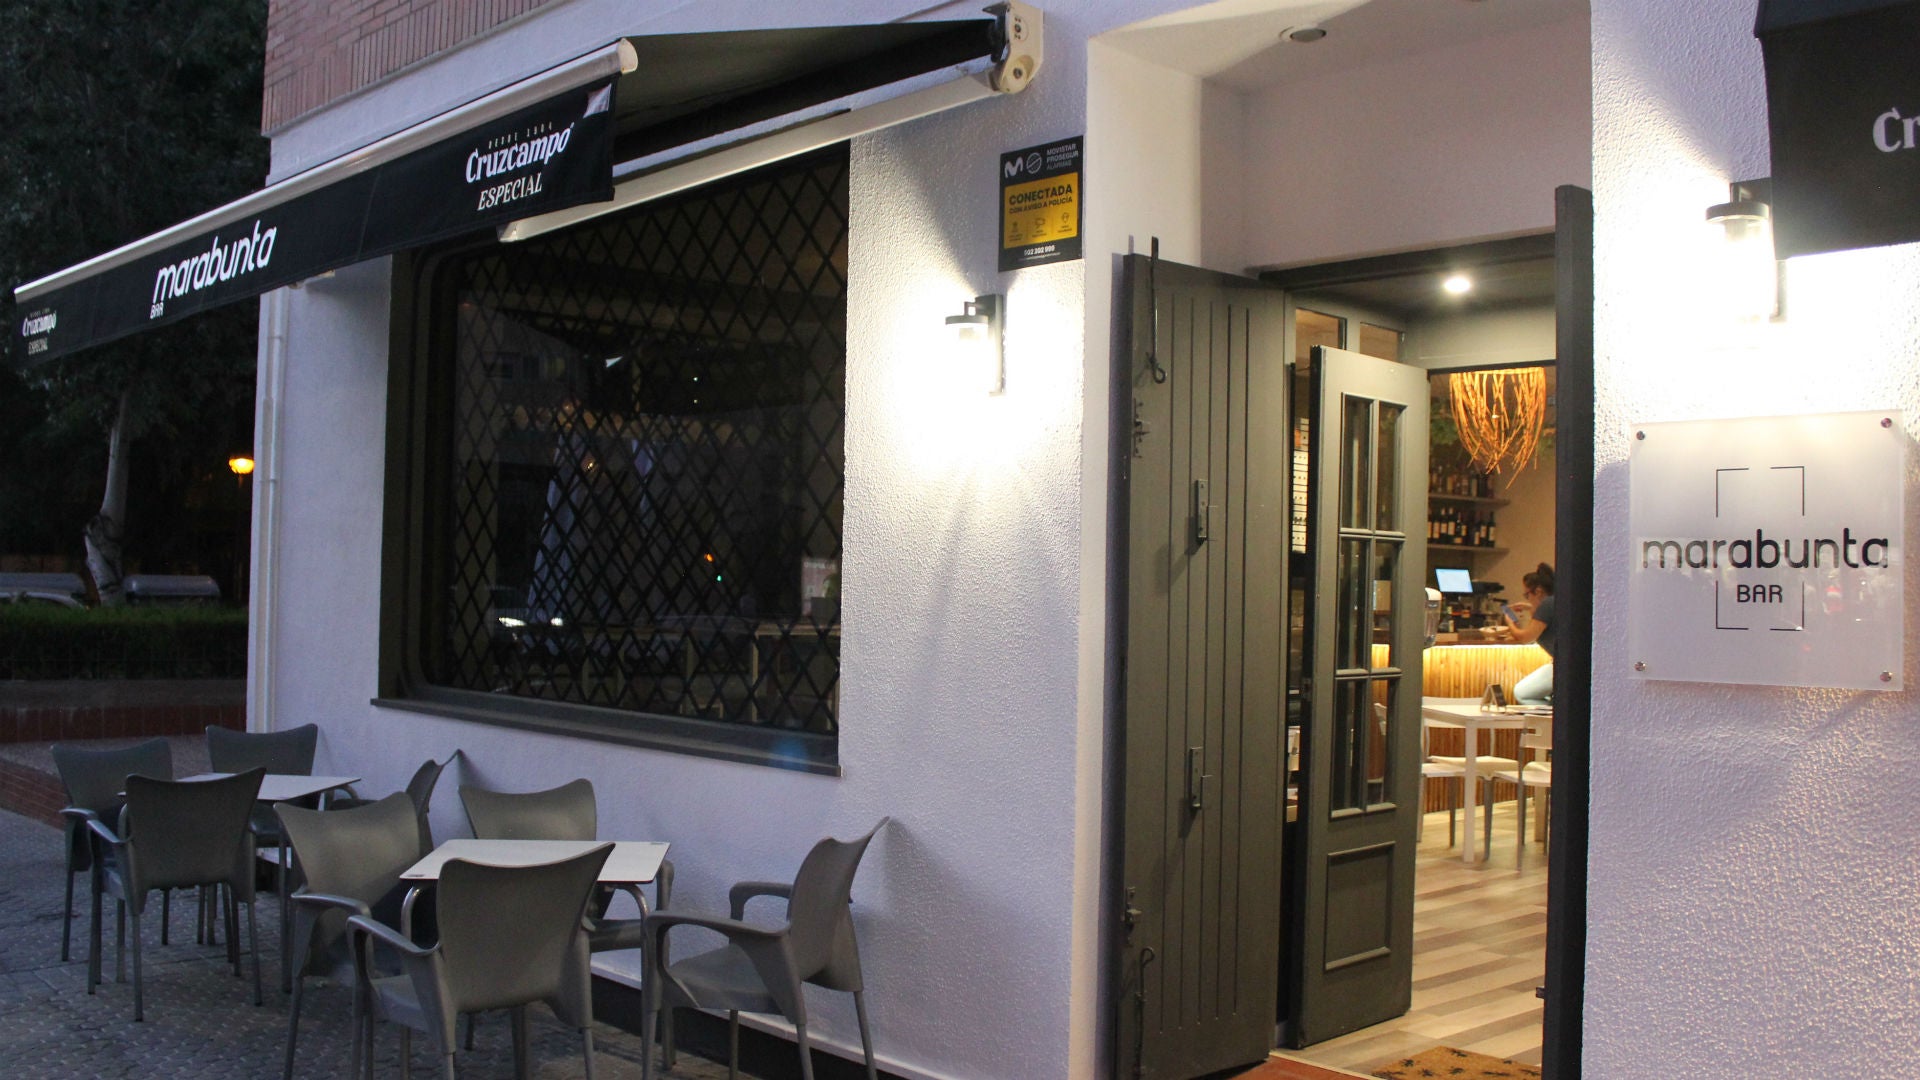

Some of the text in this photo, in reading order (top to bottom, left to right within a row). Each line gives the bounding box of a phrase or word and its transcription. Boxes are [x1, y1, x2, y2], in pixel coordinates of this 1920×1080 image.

[465, 121, 575, 184] Cruzcampo
[1046, 143, 1077, 156] MOVISTAR
[477, 172, 542, 211] ESPECIAL
[1008, 184, 1073, 206] CONECTADA
[152, 219, 278, 305] marabunta
[150, 301, 165, 320] BAR
[1642, 527, 1889, 569] marabunta
[1736, 584, 1783, 603] BAR
